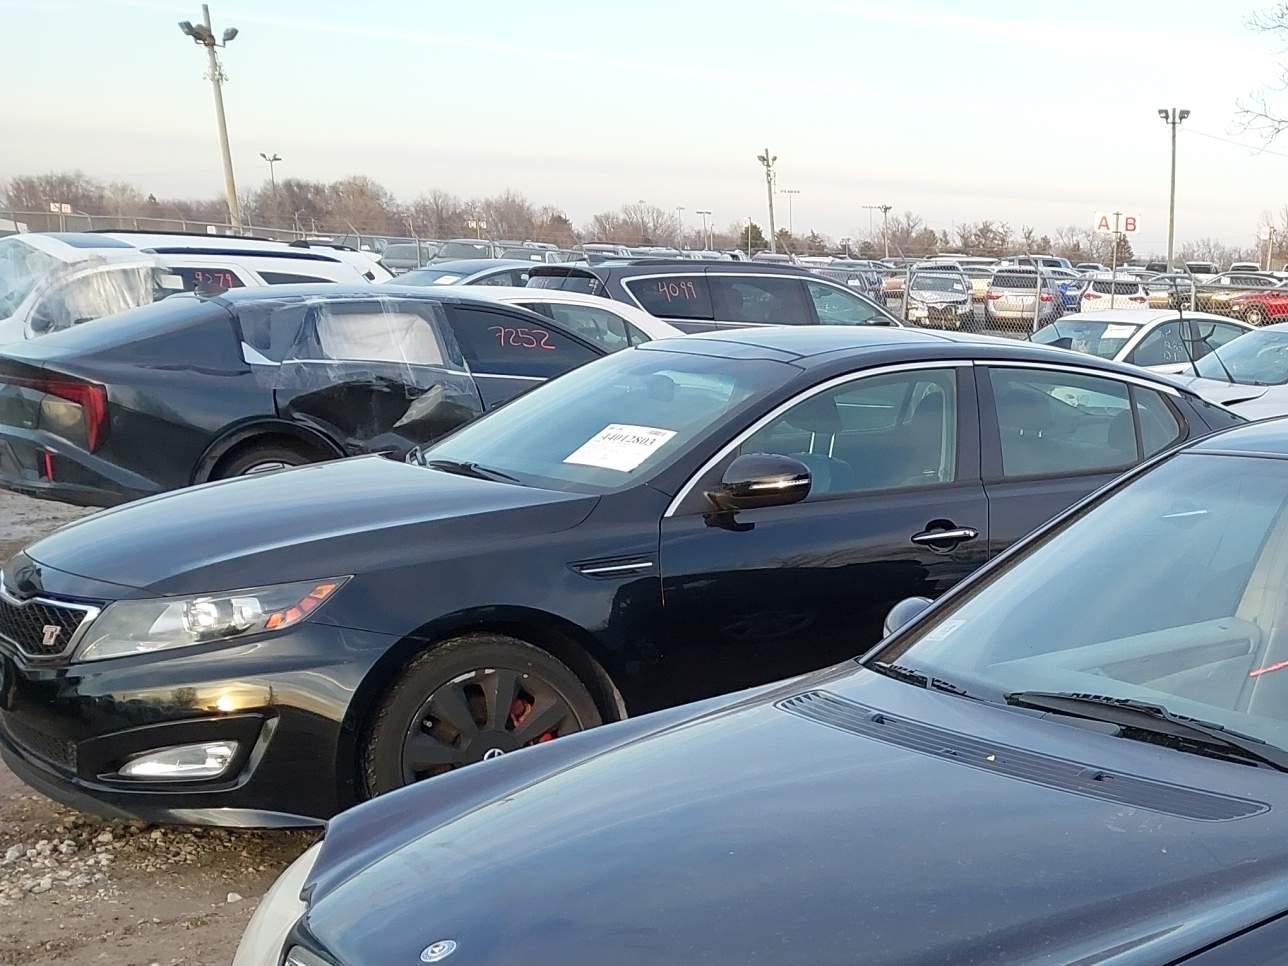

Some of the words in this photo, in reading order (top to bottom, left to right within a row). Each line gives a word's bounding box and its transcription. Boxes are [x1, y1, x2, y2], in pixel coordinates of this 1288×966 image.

[1097, 215, 1110, 231] A
[1125, 216, 1137, 232] B
[657, 280, 698, 303] 4099
[487, 325, 557, 350] 7252
